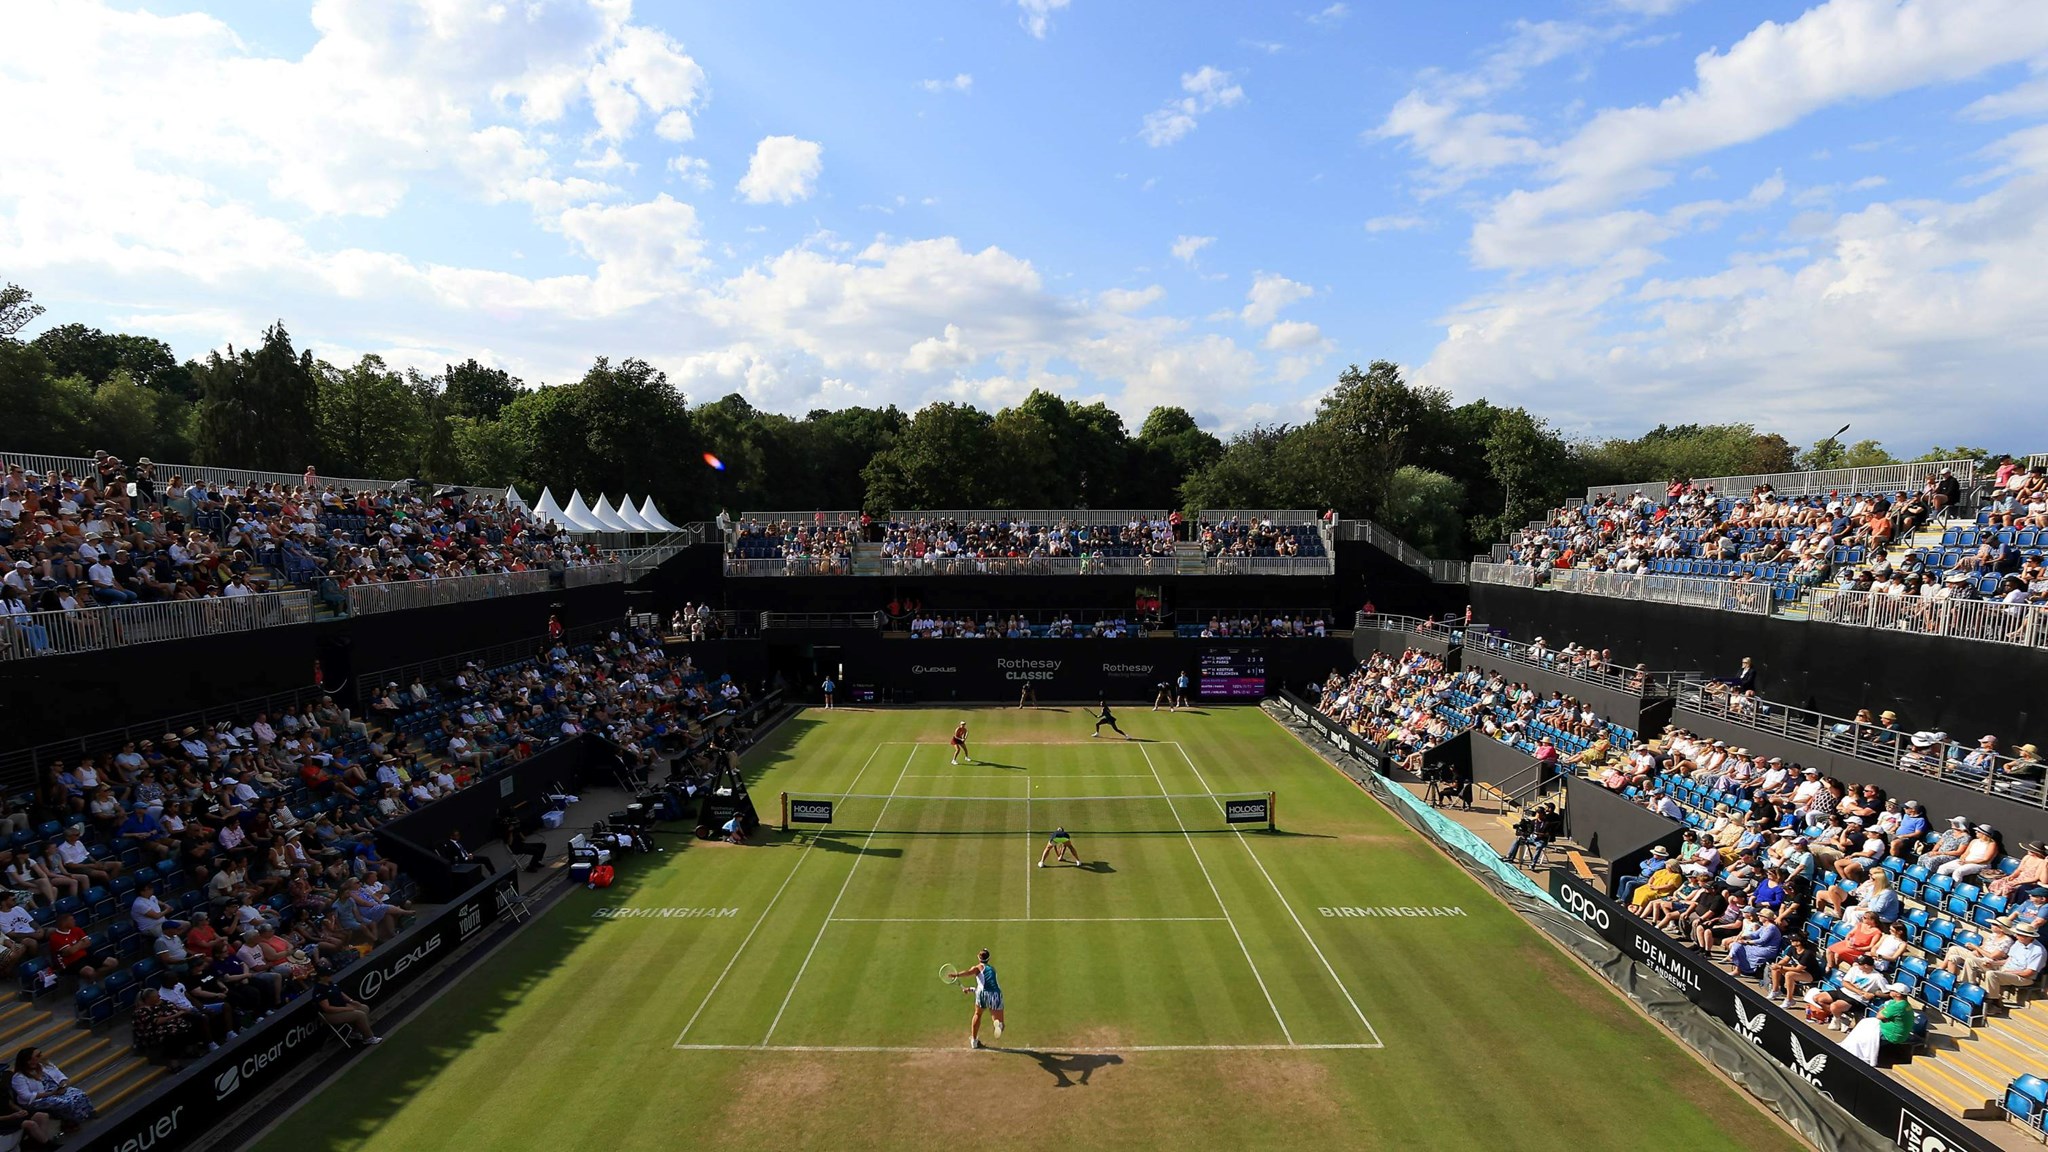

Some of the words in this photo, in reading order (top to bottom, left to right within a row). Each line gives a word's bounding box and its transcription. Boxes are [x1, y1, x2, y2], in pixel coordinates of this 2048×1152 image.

[997, 658, 1062, 670] Rothesay
[1102, 663, 1154, 673] Rothesay
[1005, 671, 1054, 680] CLASSIC
[794, 805, 830, 813] HOLOGIC
[1228, 805, 1265, 813] HOLOGIC
[591, 907, 739, 918] BIRMINGHAM
[1318, 907, 1468, 917] BIRMINGHAM
[1560, 883, 1610, 930] oppo
[459, 908, 481, 935] YOUTH
[383, 933, 441, 981] LEXUS
[1646, 958, 1654, 970] ST
[1654, 965, 1687, 992] ANDREWS
[241, 1041, 283, 1079] Clear
[113, 1105, 184, 1152] euer
